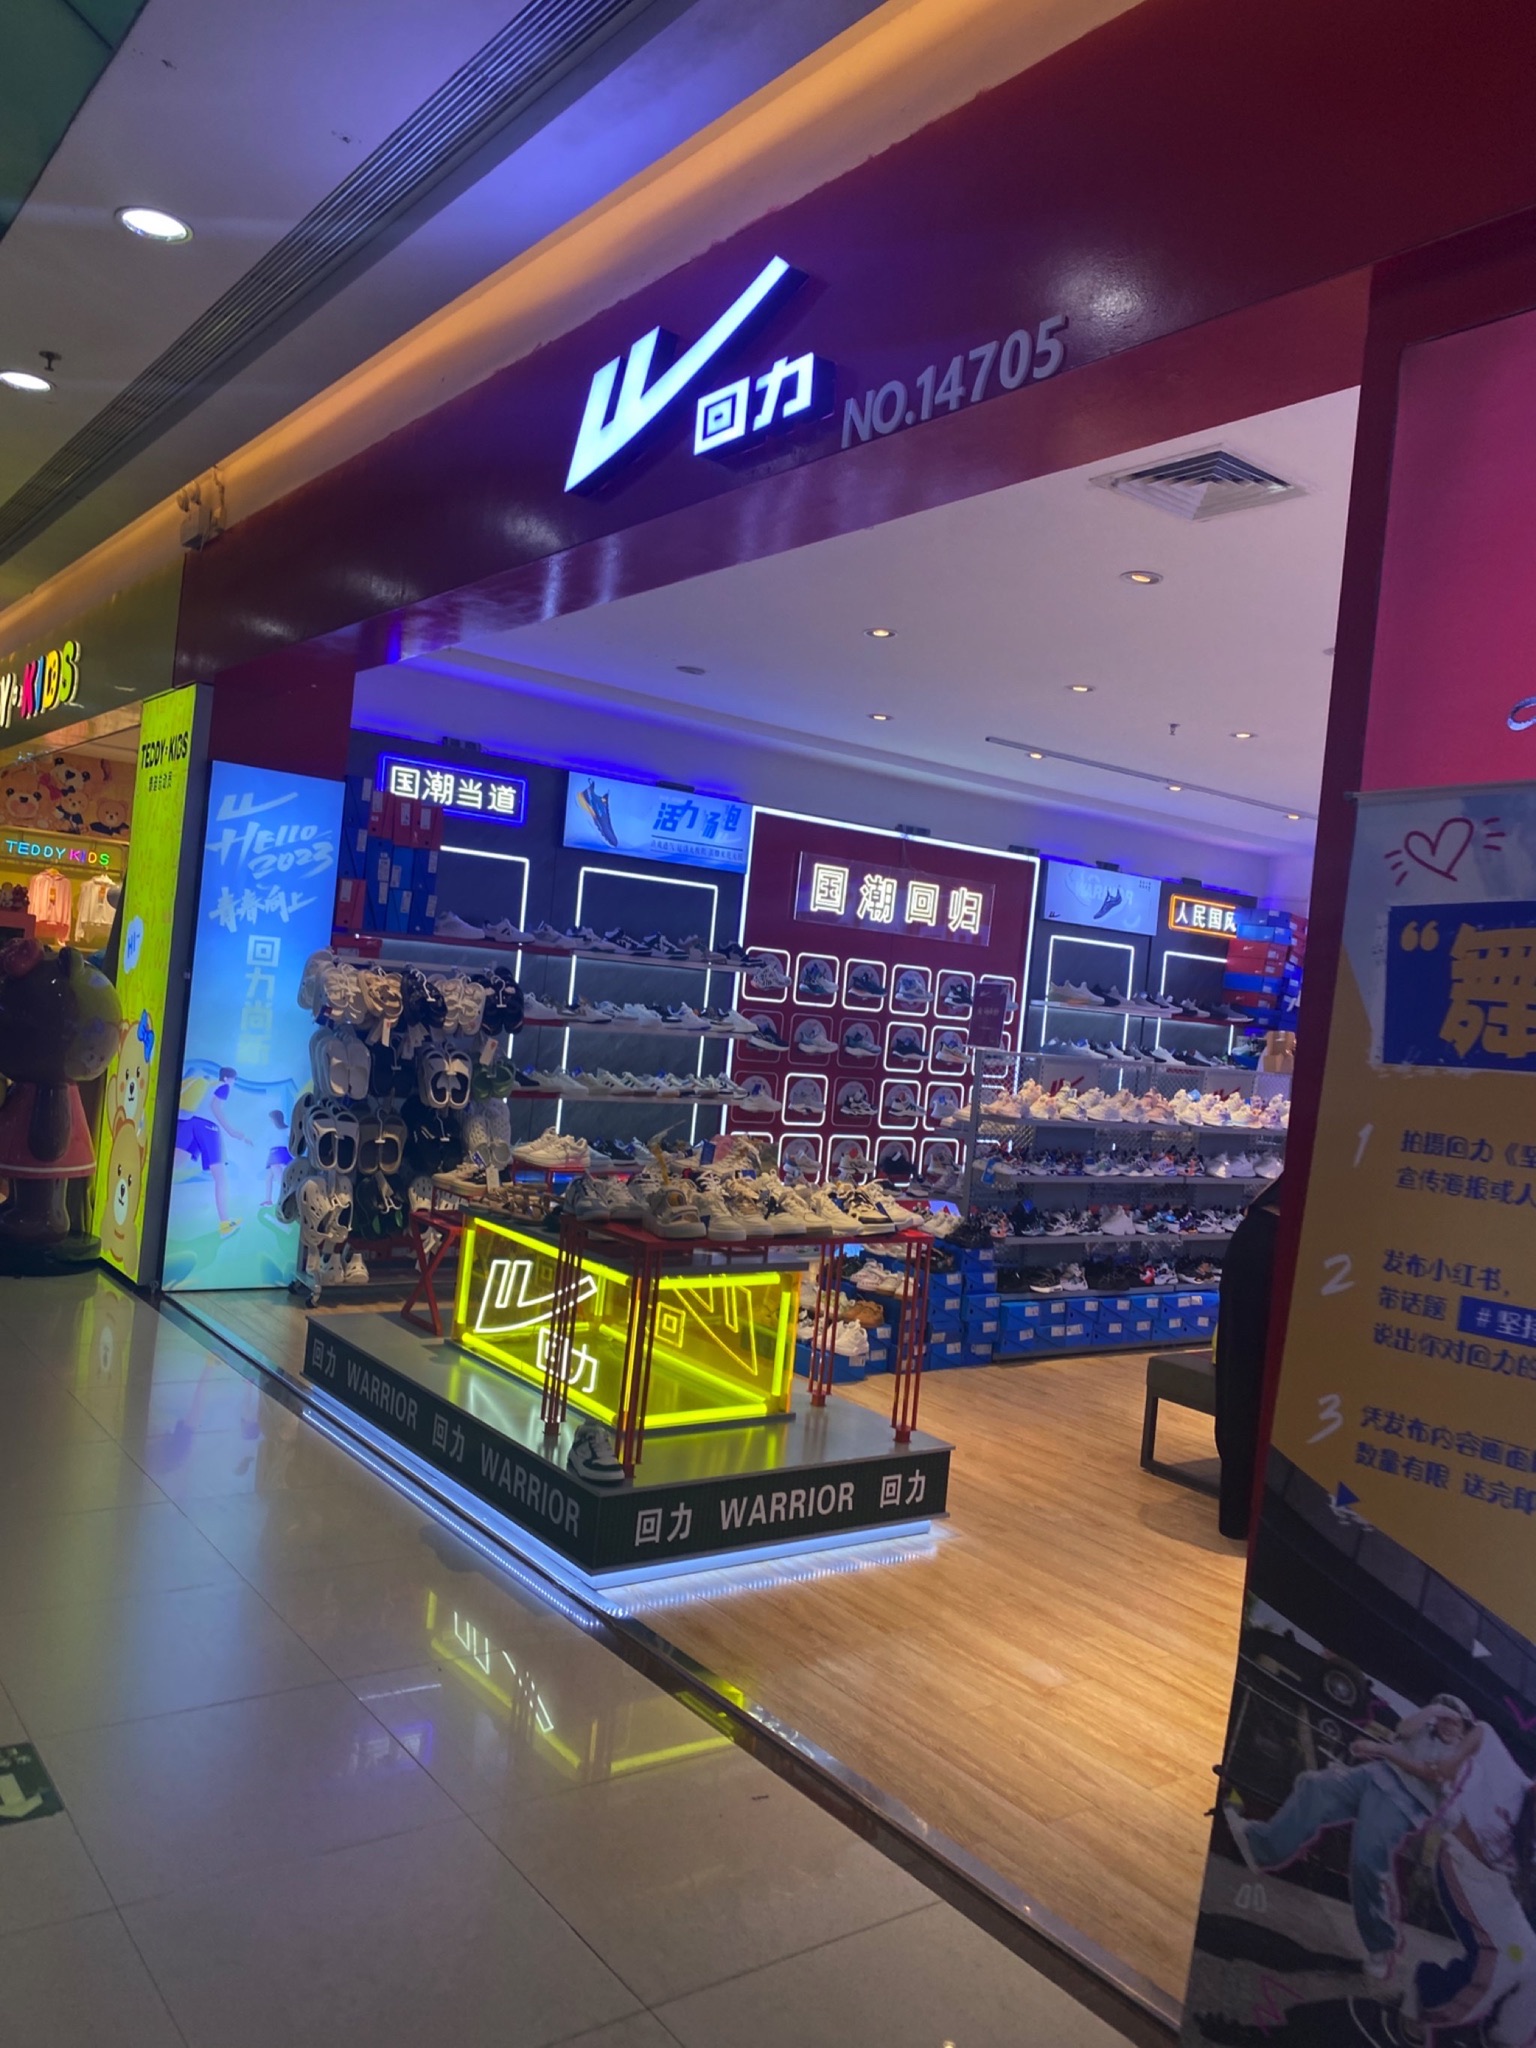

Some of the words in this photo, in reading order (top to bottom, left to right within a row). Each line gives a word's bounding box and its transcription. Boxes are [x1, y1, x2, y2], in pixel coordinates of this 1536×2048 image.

[694, 352, 814, 455] 回力
[841, 315, 1067, 448] NO.14705
[390, 765, 516, 814] 国潮当道
[6, 840, 66, 859] TEDDY
[69, 848, 110, 865] KIDS
[248, 841, 334, 879] 2023
[209, 884, 318, 933] 青春向上
[810, 863, 983, 934] 国潮回归
[1353, 1123, 1374, 1168] 1
[1320, 1253, 1355, 1296] 2
[312, 1337, 336, 1378] 回力
[347, 1359, 418, 1431] WARRIOR
[1307, 1393, 1344, 1444] 3
[432, 1413, 465, 1463] 回力
[1360, 1405, 1536, 1473] 凭发布内容画面
[481, 1442, 581, 1538] WARRIOR
[879, 1469, 926, 1508] 回力
[1355, 1441, 1450, 1490] 数量有限
[634, 1502, 692, 1546] 回力
[720, 1482, 855, 1530] WARRIOR
